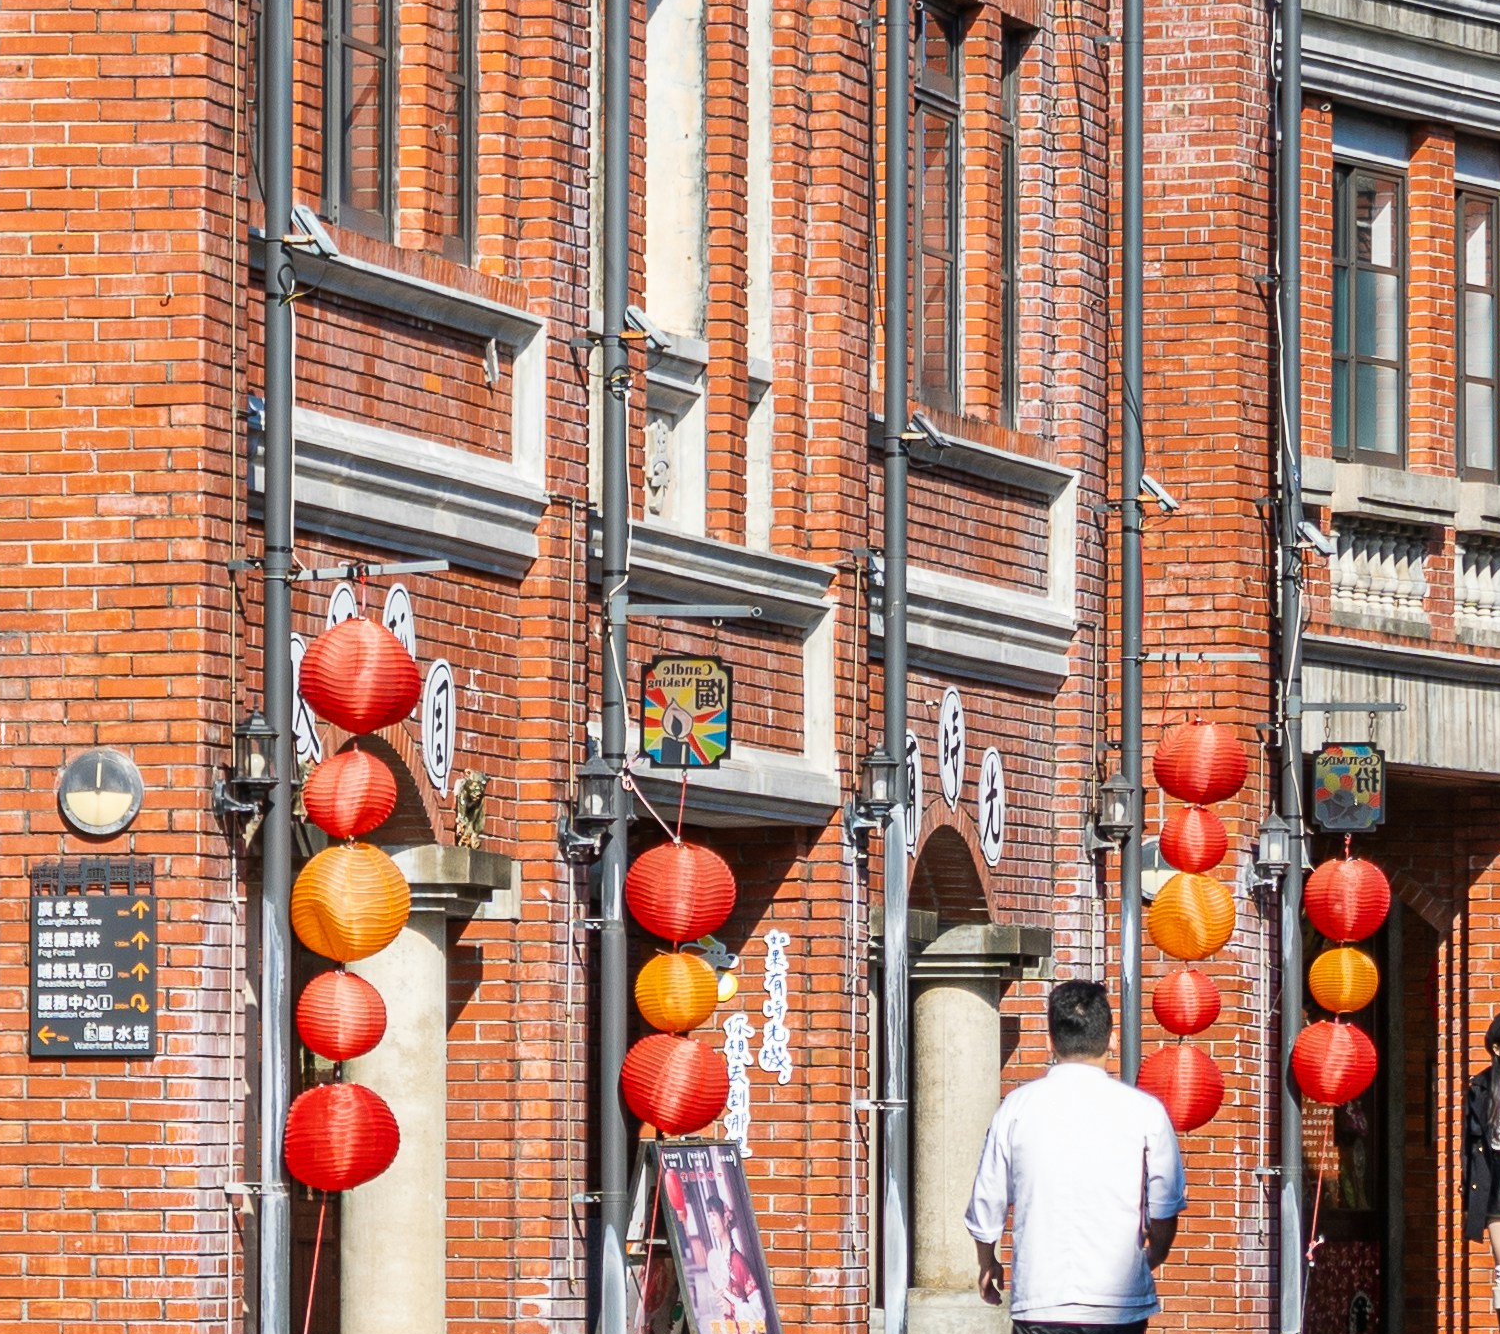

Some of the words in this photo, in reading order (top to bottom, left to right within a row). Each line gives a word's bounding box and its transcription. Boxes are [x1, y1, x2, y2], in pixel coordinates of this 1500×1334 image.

[38, 931, 101, 948] 迷霧森林
[37, 949, 52, 958] Fog
[53, 949, 76, 957] Forest
[38, 994, 99, 1011] 服務中心
